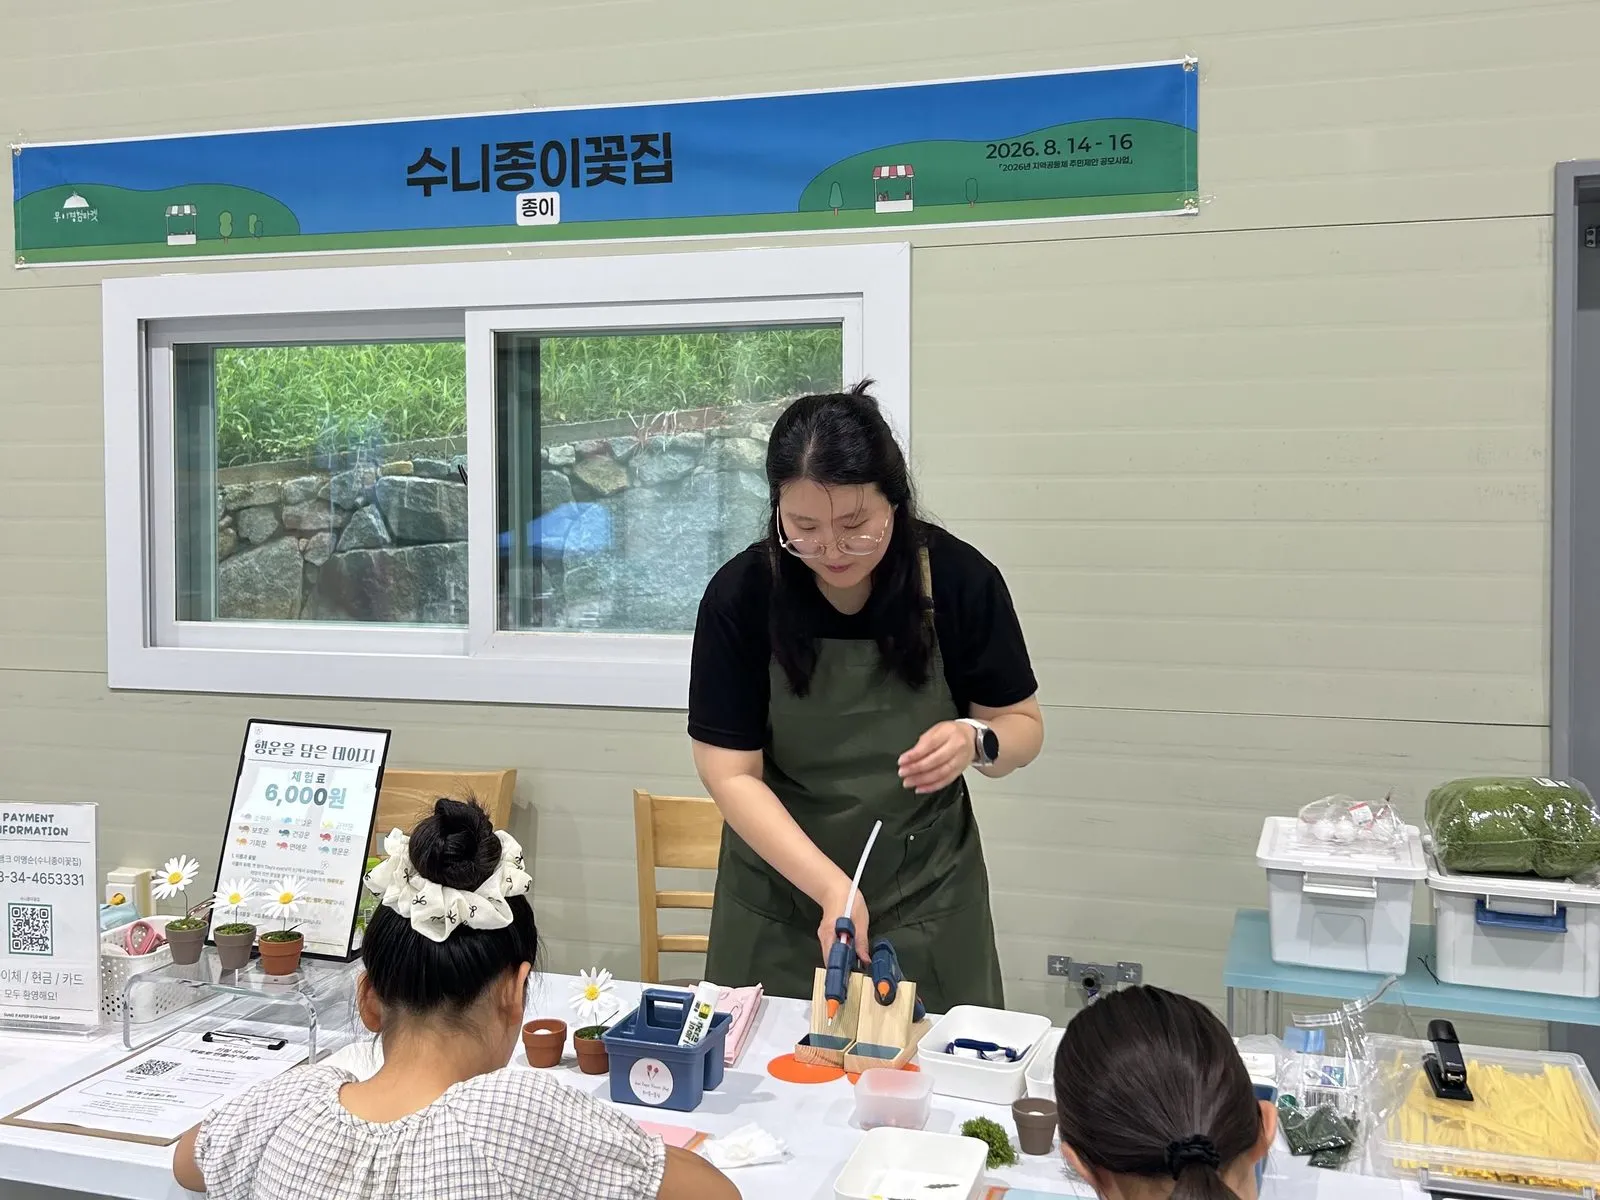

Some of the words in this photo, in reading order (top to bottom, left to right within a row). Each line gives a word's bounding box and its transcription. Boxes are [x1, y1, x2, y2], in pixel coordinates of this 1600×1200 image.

[985, 141, 1039, 159] 2026.
[1043, 139, 1060, 156] 8.
[1067, 136, 1092, 154] 14
[1108, 133, 1133, 151] 16
[406, 132, 673, 197] 수니종이꽃집
[521, 197, 554, 217] 종이
[254, 740, 295, 757] 행운을
[300, 743, 328, 760] 담은
[332, 746, 376, 764] 데이지
[291, 770, 326, 784] 체험료
[265, 783, 347, 810] 6,000원
[3, 812, 55, 823] PAYMENT
[1, 969, 22, 983] 이체
[24, 971, 29, 984] /
[32, 971, 53, 985] 현금
[55, 972, 60, 985] /
[62, 972, 85, 986] 카드
[4, 989, 20, 999] 모두
[23, 990, 58, 1002] 환영해요!
